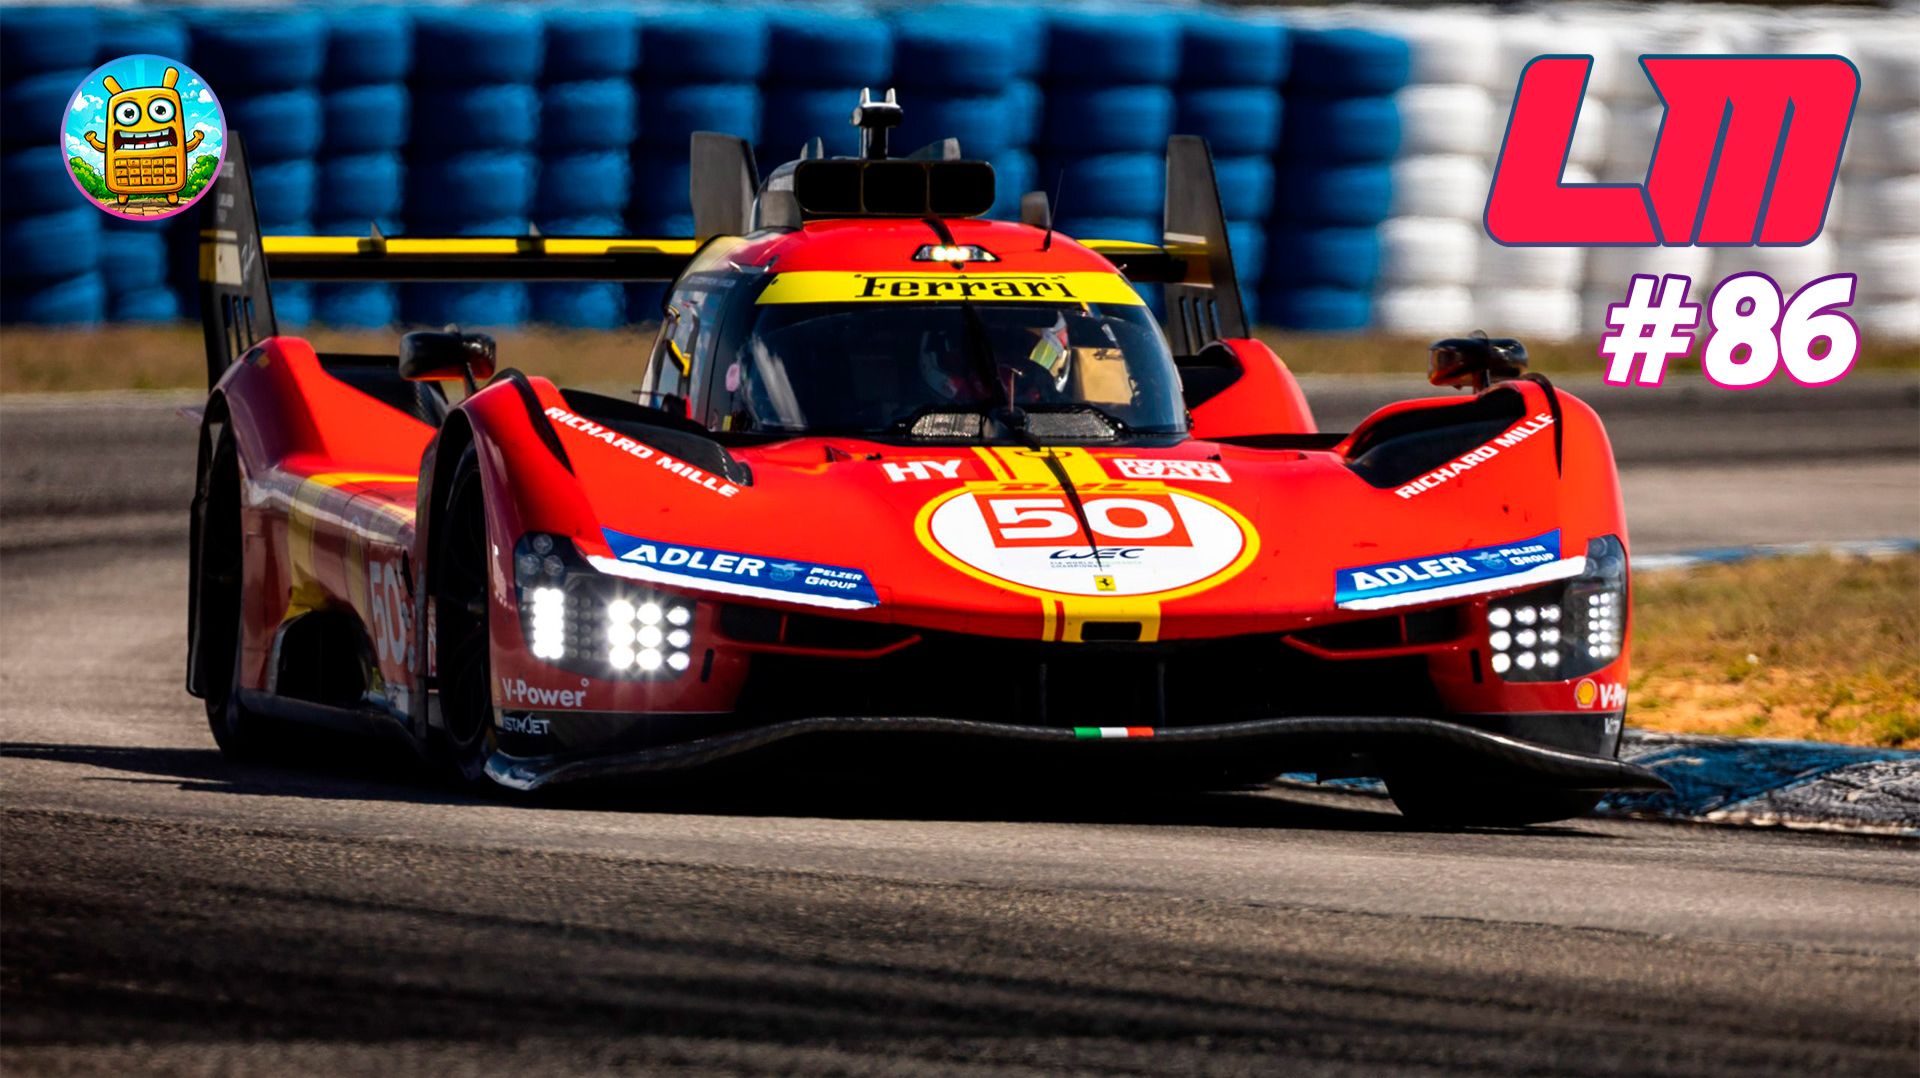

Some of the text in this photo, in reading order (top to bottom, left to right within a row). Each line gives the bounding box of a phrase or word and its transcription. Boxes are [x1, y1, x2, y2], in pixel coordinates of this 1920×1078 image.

[855, 274, 1077, 298] Ferrari
[544, 407, 740, 498] RICHARD MILLE
[1394, 413, 1555, 499] RICHARD MILLE
[881, 460, 962, 483] HY
[989, 498, 1175, 539] 50
[620, 544, 766, 577] ADLER
[1049, 548, 1145, 559] WEC
[1499, 544, 1546, 558] PELZER
[1509, 553, 1555, 566] GROUP
[805, 576, 857, 590] GROUP
[810, 567, 863, 581] PELZER
[1352, 557, 1476, 591] ADLER
[502, 678, 587, 707] V-Power
